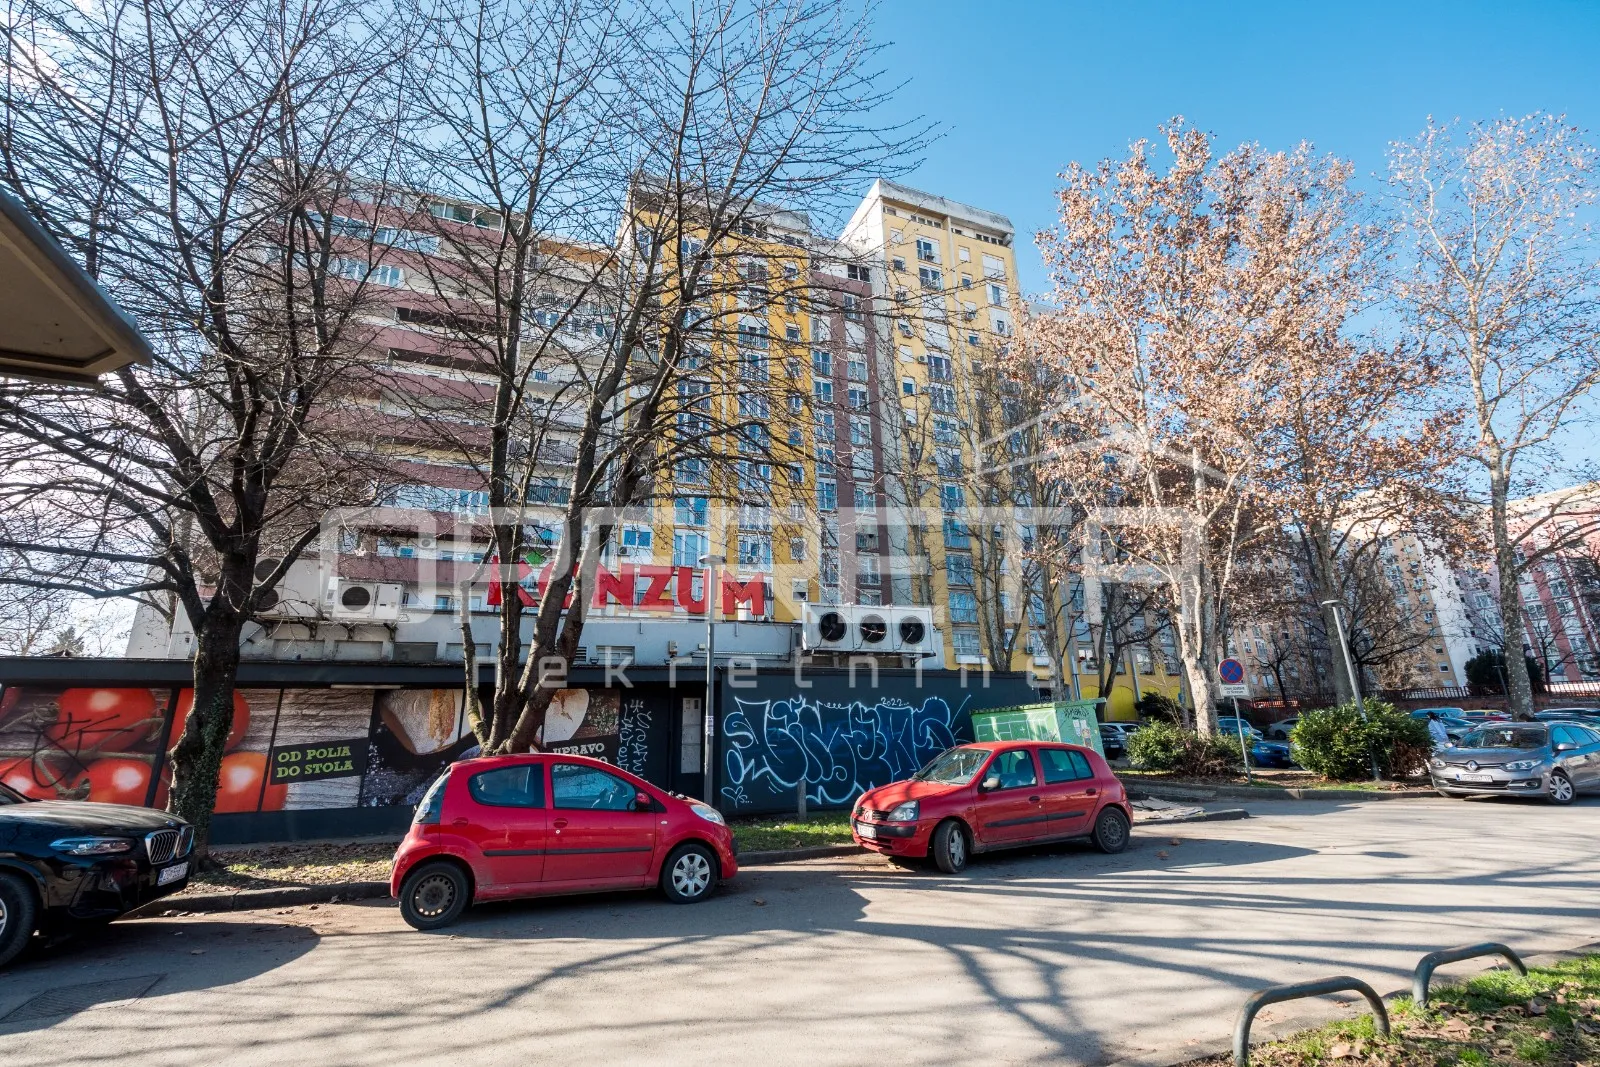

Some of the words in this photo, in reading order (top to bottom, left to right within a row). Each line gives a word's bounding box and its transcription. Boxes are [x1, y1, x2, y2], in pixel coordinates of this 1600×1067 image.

[278, 751, 301, 762] OD
[306, 746, 351, 760] POLJA
[276, 765, 300, 778] DO
[305, 760, 353, 774] STOLA
